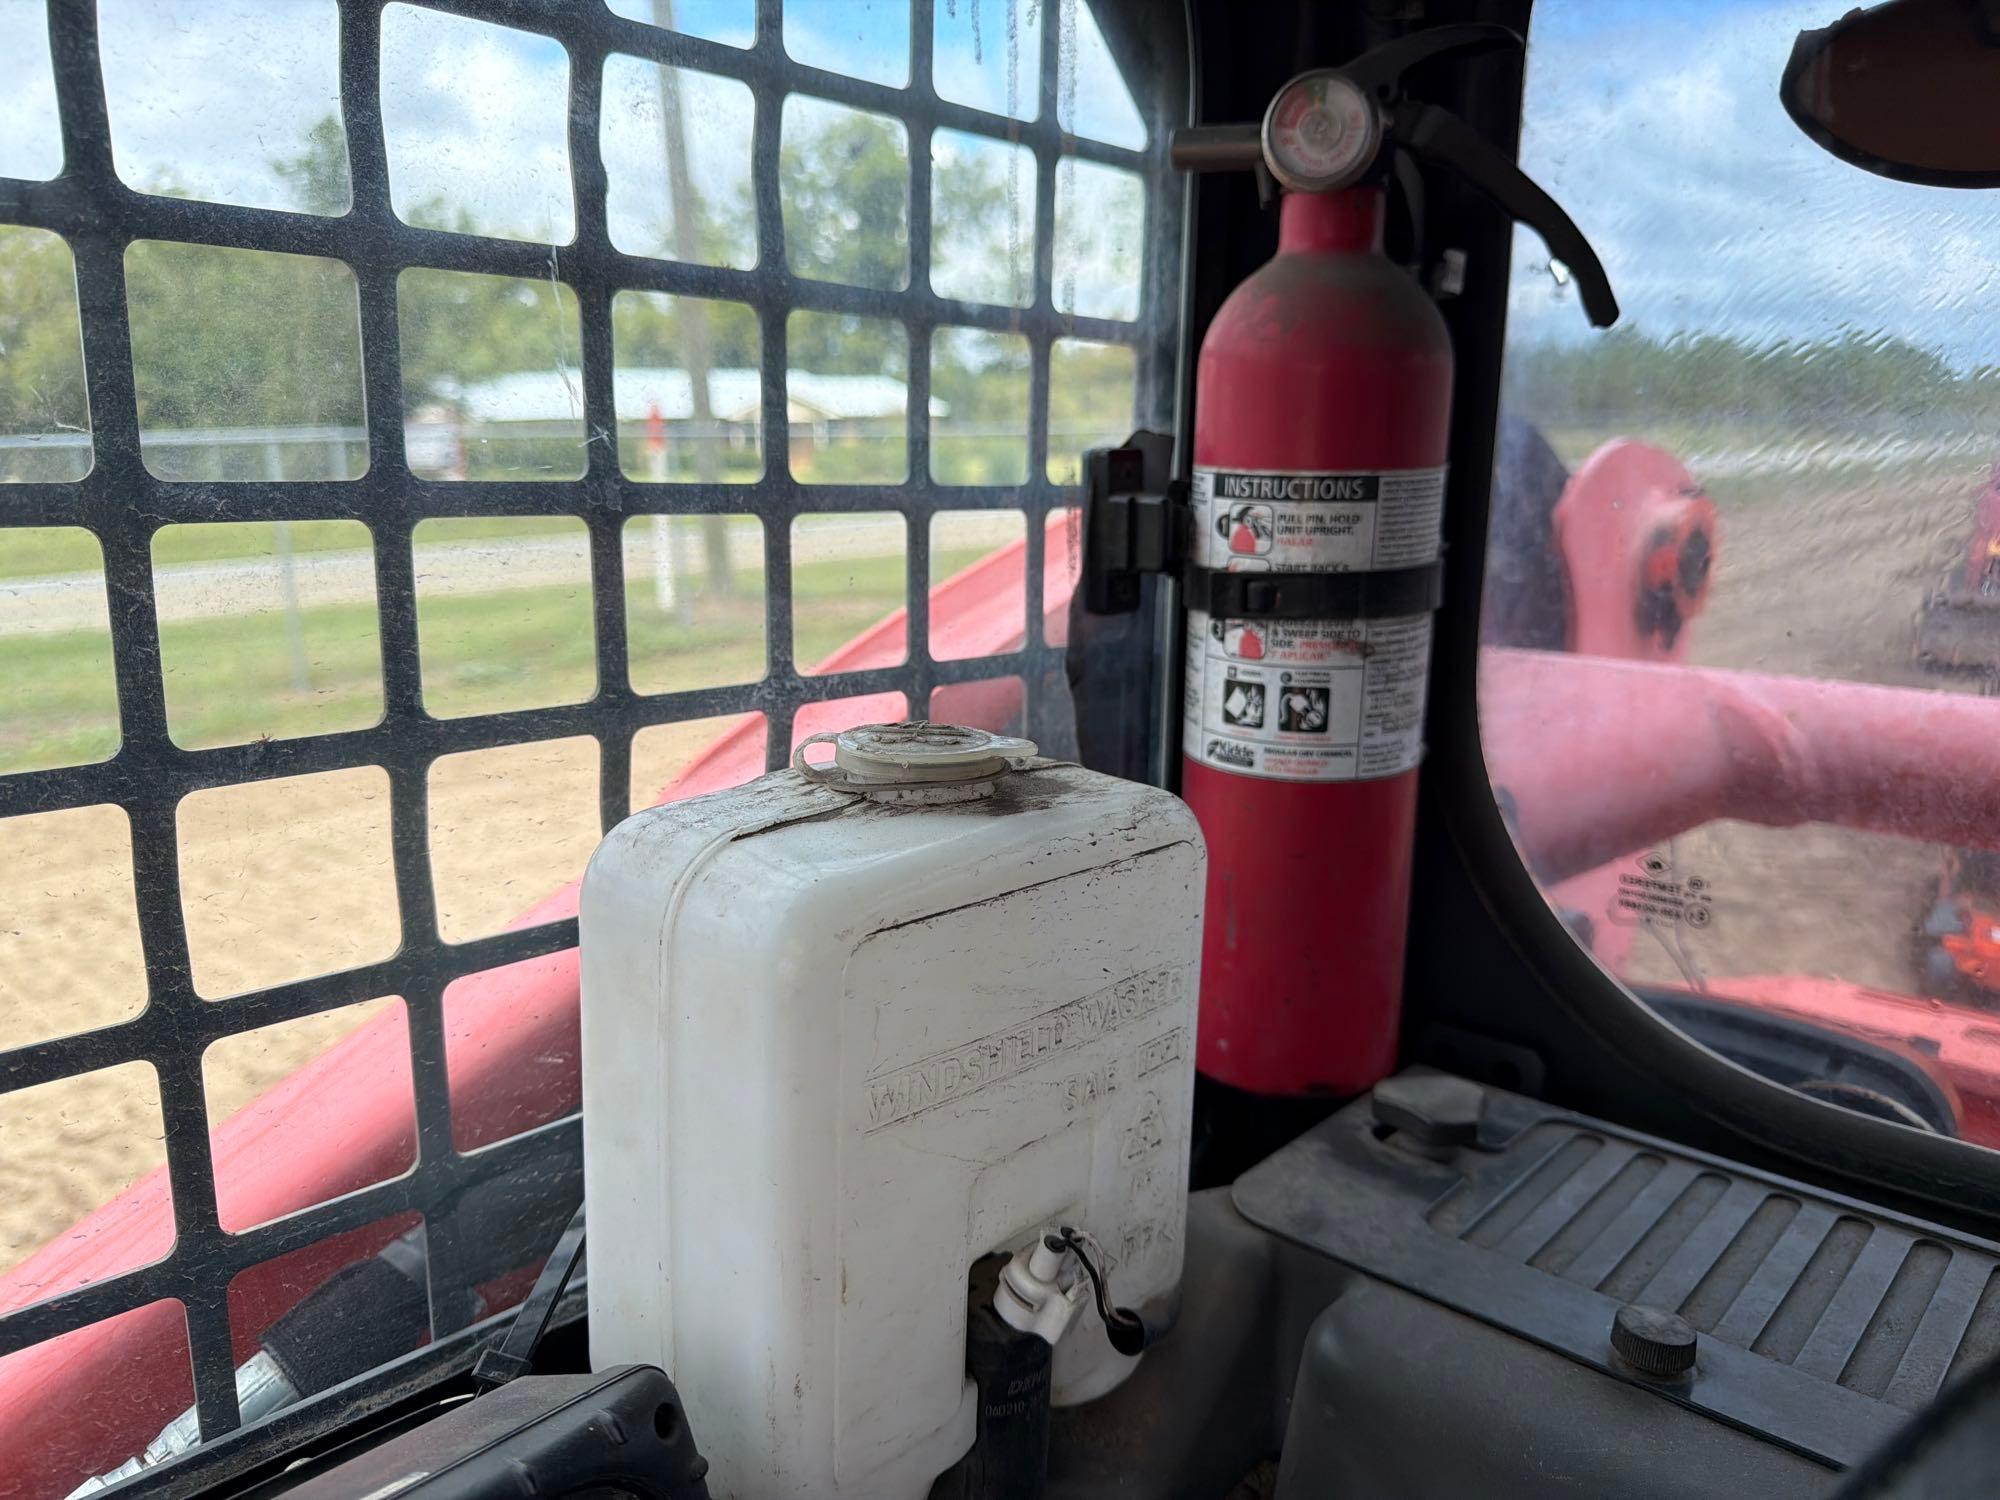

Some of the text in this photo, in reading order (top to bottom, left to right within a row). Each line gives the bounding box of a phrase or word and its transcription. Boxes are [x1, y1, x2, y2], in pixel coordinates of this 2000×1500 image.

[1224, 477, 1365, 500] INSTRUCTIONS
[1277, 514, 1301, 525] PULL
[1329, 514, 1361, 524] HOLD
[1277, 526, 1302, 536] UNIT
[1283, 629, 1318, 639] SWEEP
[1321, 629, 1345, 639] SIDE
[1347, 629, 1361, 639] TO
[866, 1010, 1070, 1122] WINDSHIELD
[1076, 970, 1184, 1040] WASHER
